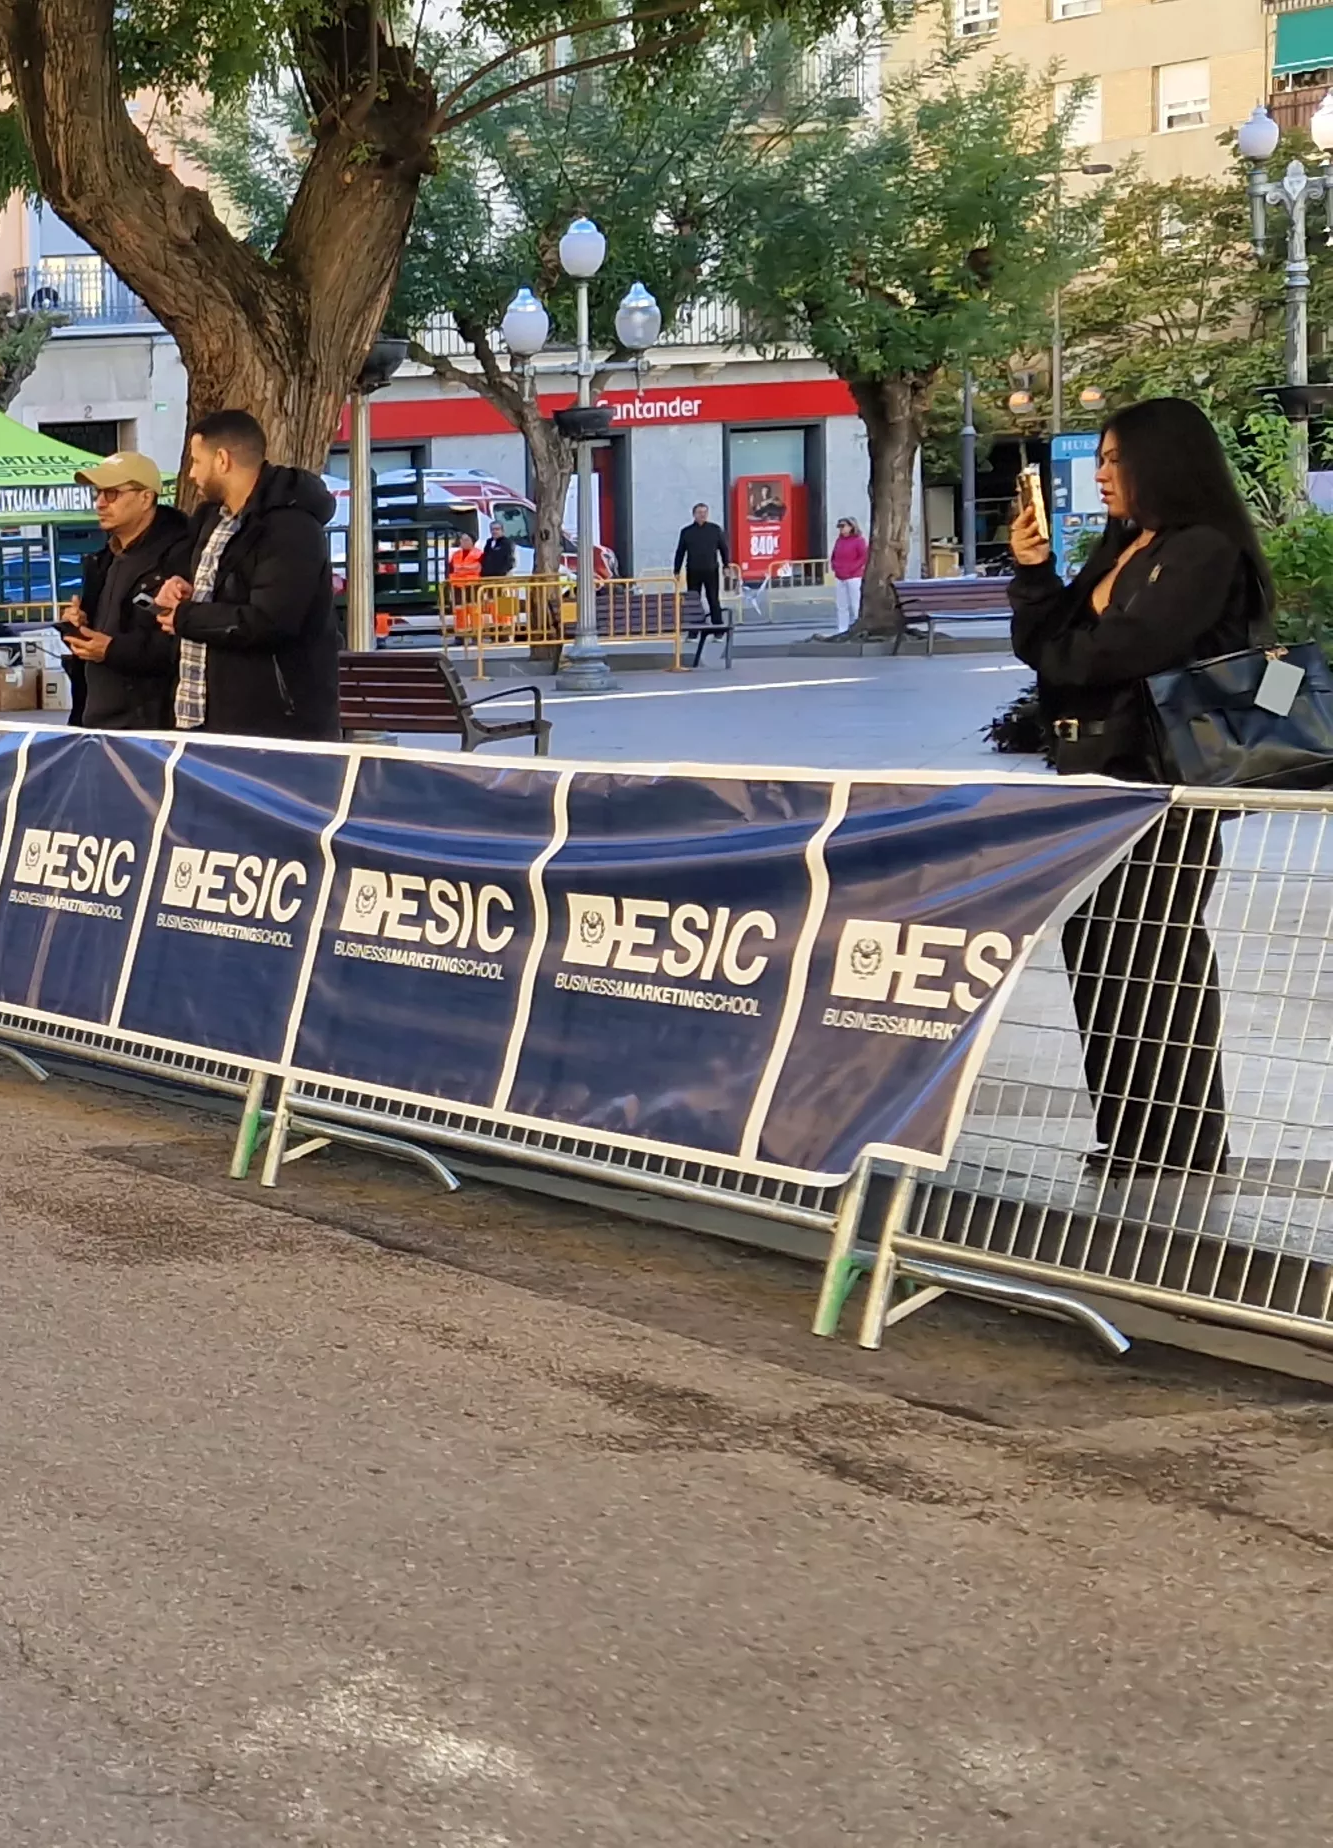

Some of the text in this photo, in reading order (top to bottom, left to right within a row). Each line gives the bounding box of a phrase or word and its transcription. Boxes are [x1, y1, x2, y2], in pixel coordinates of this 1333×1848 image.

[1061, 440, 1100, 451] HUES
[44, 831, 135, 897] ESIC
[197, 851, 307, 923] ESIC
[384, 873, 515, 953] ESIC
[613, 898, 777, 986] ESIC
[334, 940, 505, 980] BUSINESS&MARKETINGSCHOOL
[894, 924, 1034, 1013] ES
[554, 972, 762, 1017] BUSINESS&MARKETINGSCHOOL
[821, 1008, 961, 1041] BUSINESS&MARK
